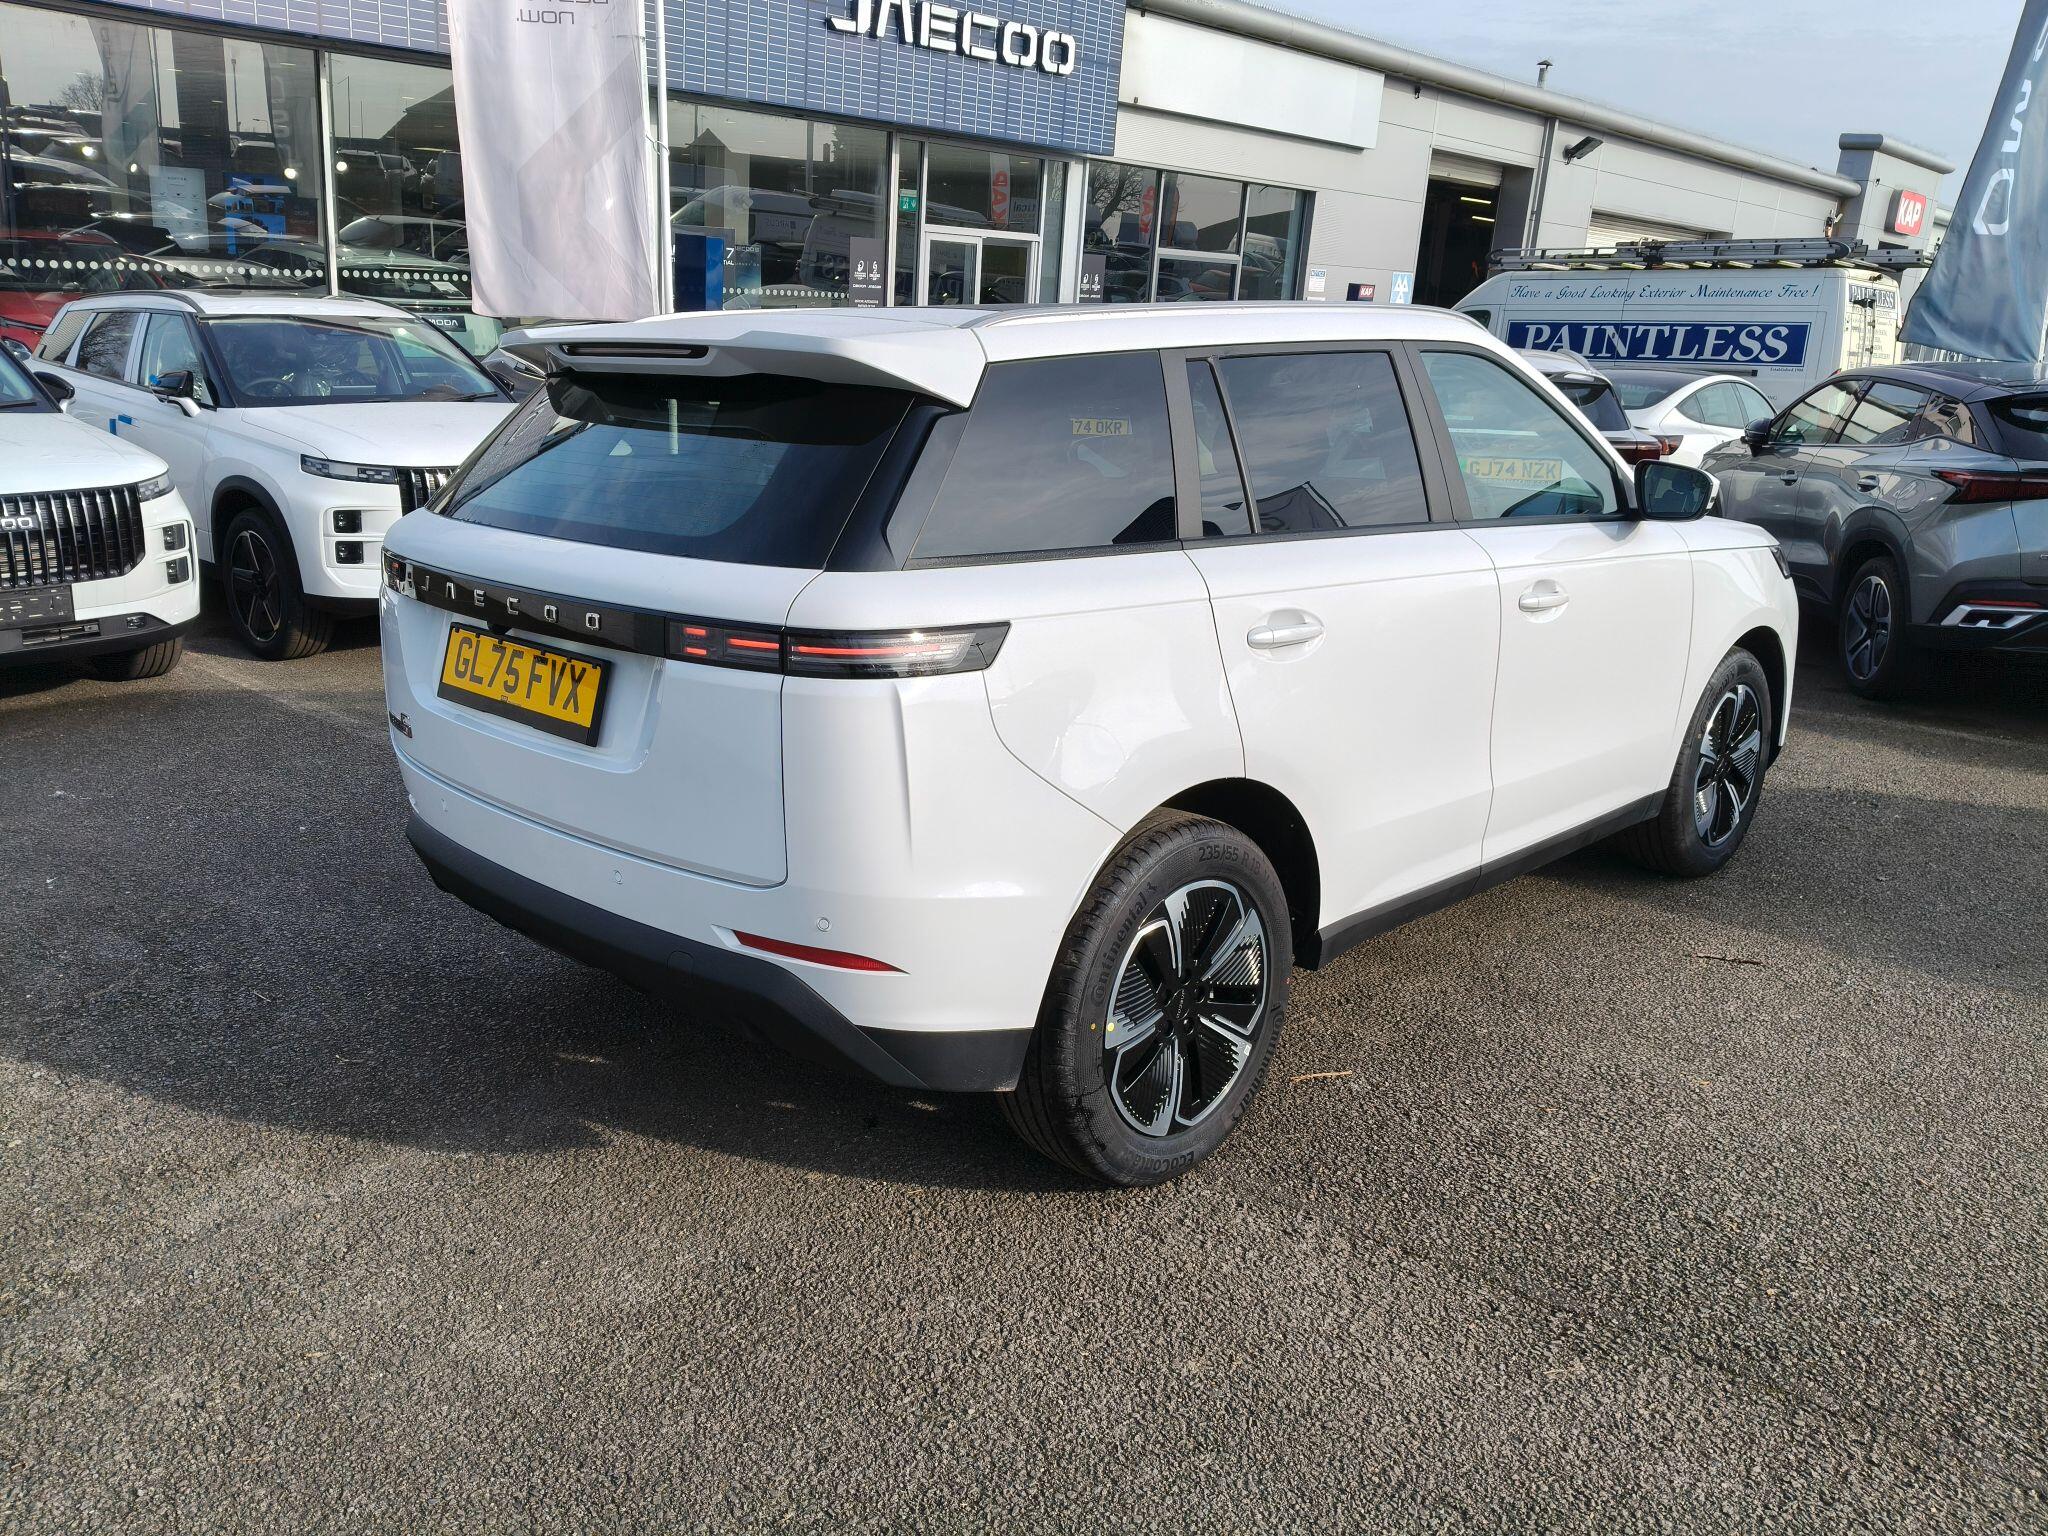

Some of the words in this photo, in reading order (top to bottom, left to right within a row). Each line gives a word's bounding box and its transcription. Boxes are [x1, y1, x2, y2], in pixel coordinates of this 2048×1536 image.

[829, 0, 1077, 75] JAECOO
[1898, 196, 1922, 228] KAP
[1360, 286, 1374, 296] KAP
[1510, 285, 1540, 298] Have
[1556, 285, 1587, 299] Good
[1590, 285, 1635, 302] Looking
[1639, 284, 1686, 298] Exterior
[1690, 284, 1773, 298] Maintenance
[427, 318, 459, 327] MODA
[1524, 323, 1789, 362] PAINTLESS
[1469, 460, 1515, 477] GJ74
[1521, 462, 1557, 479] NZK
[420, 574, 601, 631] JAECOO
[453, 636, 525, 695] GL75
[525, 654, 588, 714] FVX
[1198, 844, 1240, 861] 235/55
